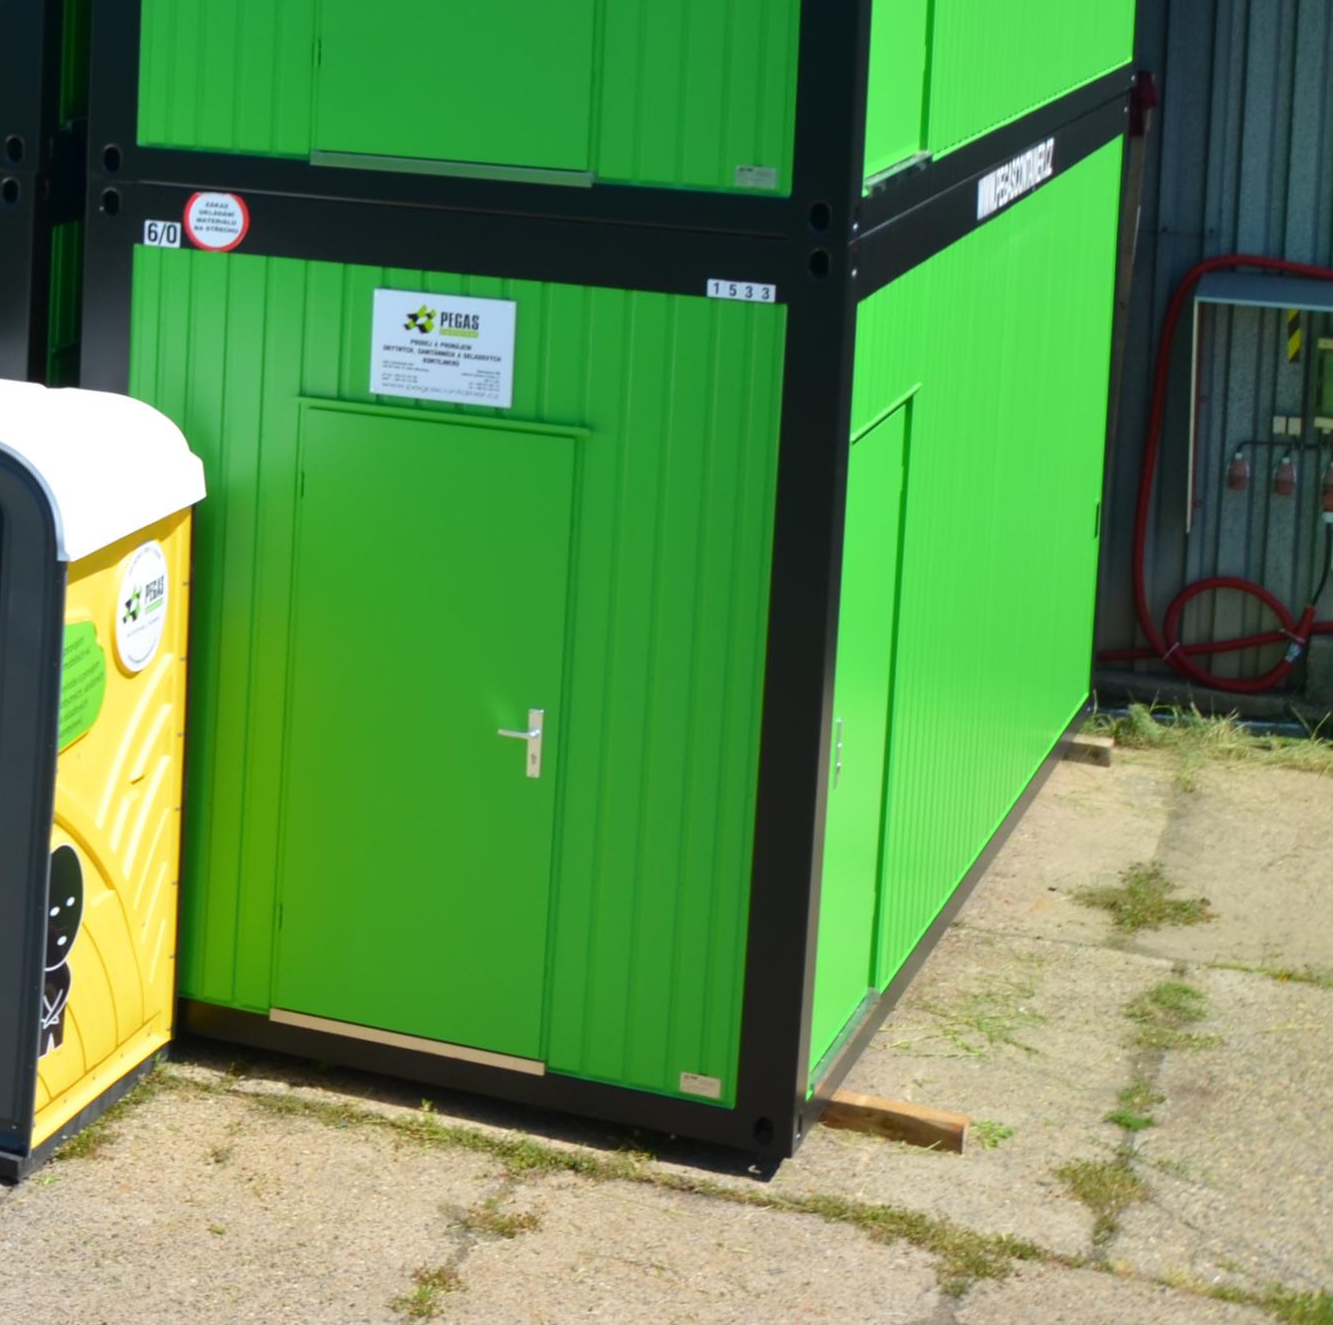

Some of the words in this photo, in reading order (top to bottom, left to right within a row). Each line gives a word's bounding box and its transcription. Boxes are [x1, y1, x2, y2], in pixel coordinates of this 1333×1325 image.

[147, 222, 177, 246] 6/0
[440, 311, 480, 331] PEGAS
[145, 575, 165, 604] PEGAS
